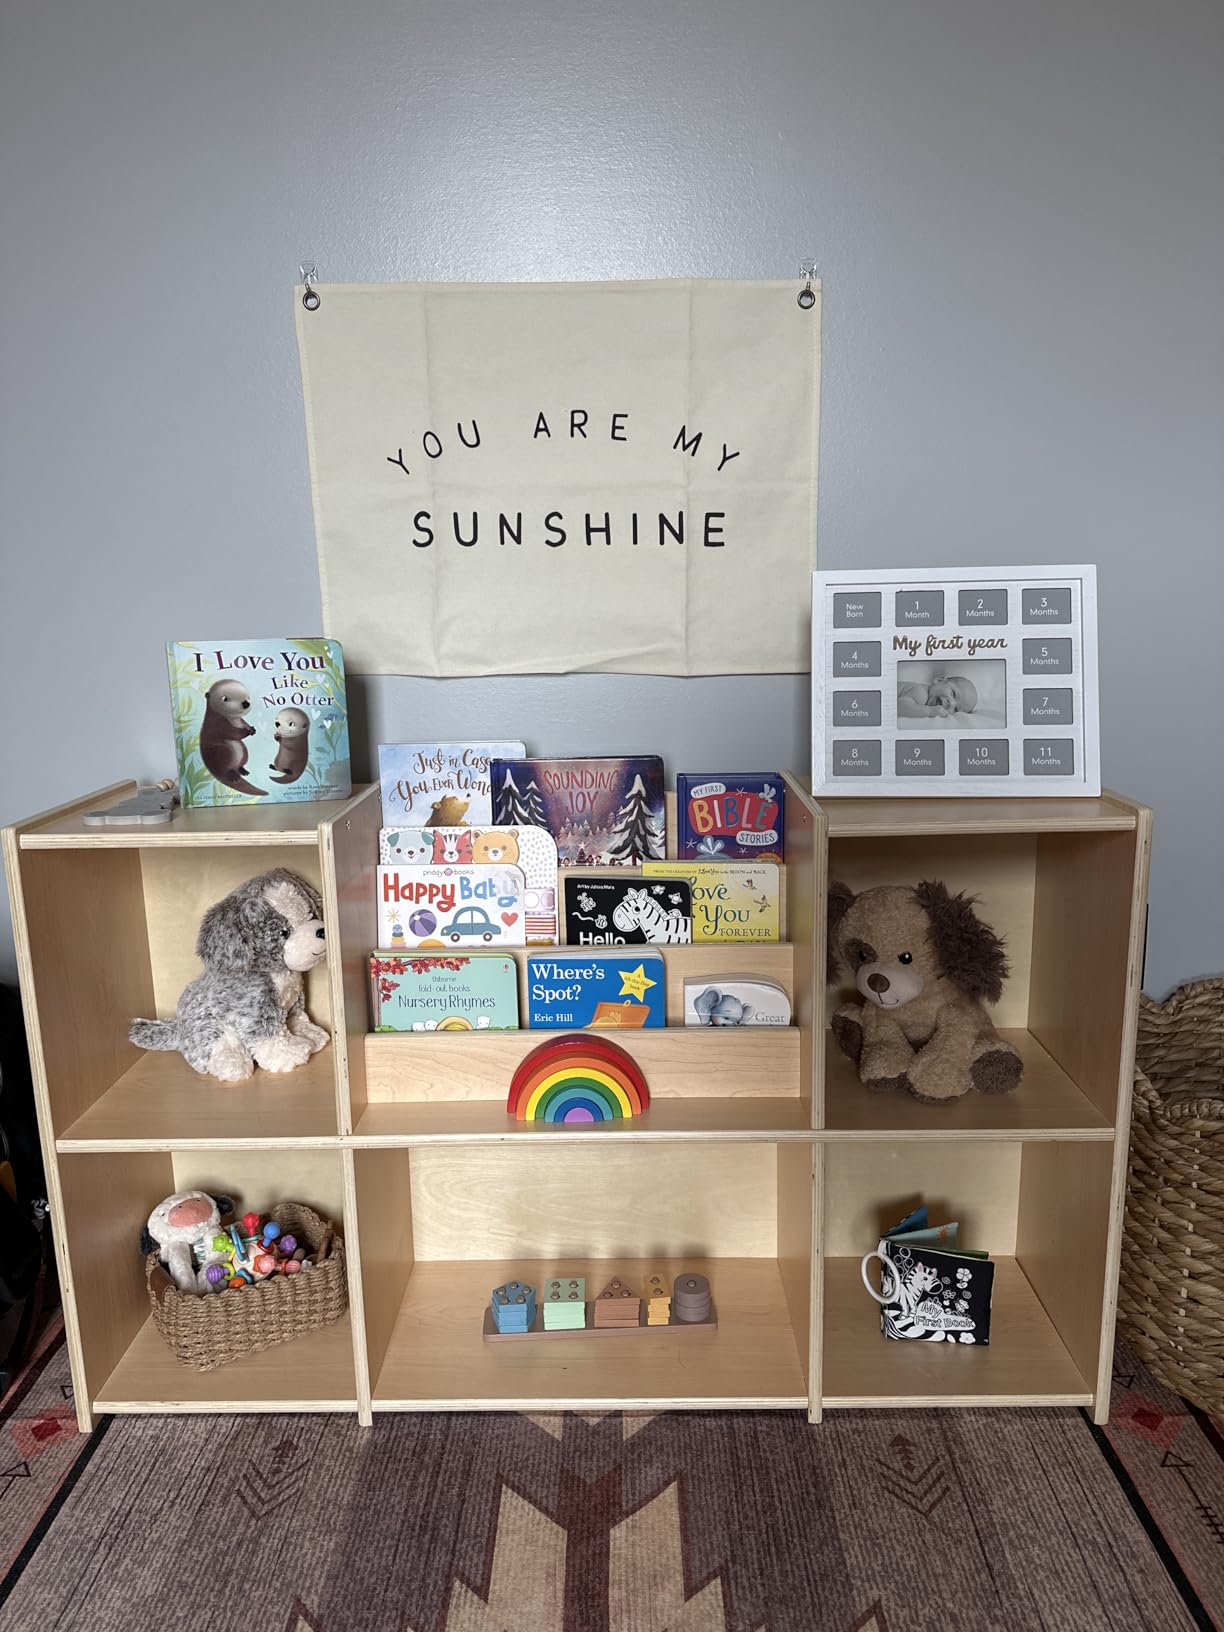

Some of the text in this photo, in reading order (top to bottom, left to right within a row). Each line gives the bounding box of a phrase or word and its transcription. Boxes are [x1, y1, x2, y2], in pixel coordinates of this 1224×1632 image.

[387, 410, 740, 475] YOU ARE MY
[412, 511, 726, 548] SUNSHINE
[914, 601, 920, 610] 1
[977, 599, 983, 609] 2
[1041, 598, 1048, 607] 3
[966, 609, 995, 617] Months
[1029, 608, 1059, 616] Months
[892, 634, 1008, 656] My first year
[851, 651, 858, 660] 4
[1042, 647, 1048, 657] 5
[193, 650, 326, 672] I Love You
[1030, 657, 1059, 665] Months
[271, 674, 308, 690] Like
[262, 692, 334, 708] No Otter
[851, 700, 858, 709] 6
[1042, 697, 1048, 707] 7
[1031, 707, 1060, 715] Months
[851, 749, 858, 757] 8
[914, 748, 920, 757] 9
[975, 748, 988, 757] 10
[1040, 747, 1051, 756] 11
[412, 748, 491, 774] Just in Case
[967, 758, 996, 766] Months
[1031, 758, 1061, 766] Months
[544, 770, 619, 795] SOUNDING
[389, 780, 429, 812] You
[693, 785, 722, 797] MY FIRST
[566, 791, 599, 815] JOY
[692, 797, 773, 833] BIBLE
[739, 833, 775, 844] STORIES
[423, 868, 475, 877] priddy books
[383, 873, 456, 913] Happy
[699, 905, 751, 935] You
[719, 928, 771, 937] FOREVER
[579, 932, 626, 945] Hello
[531, 963, 605, 980] Where's
[532, 984, 581, 1004] Spot?
[398, 994, 496, 1011] Nursery Rhymes
[534, 1013, 573, 1022] Eric Hill
[755, 1012, 785, 1023] Great
[921, 1303, 942, 1319] My
[916, 1316, 974, 1328] First Book
